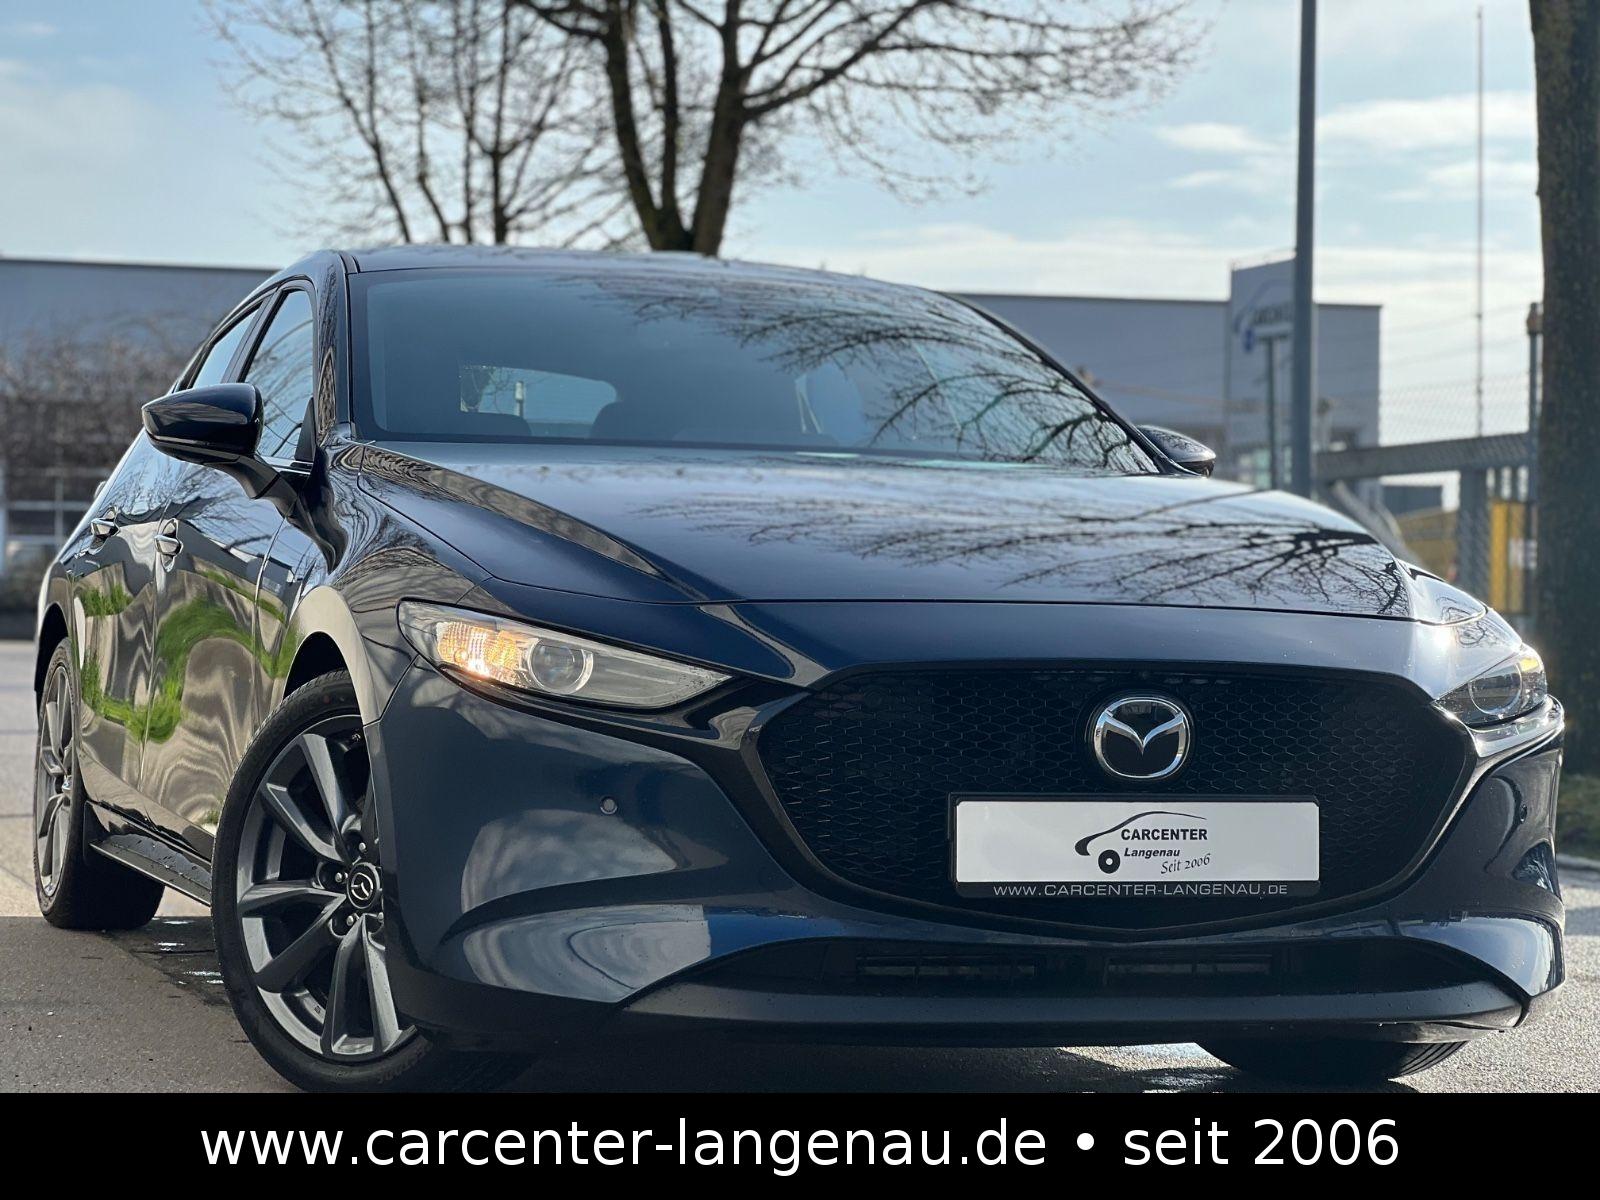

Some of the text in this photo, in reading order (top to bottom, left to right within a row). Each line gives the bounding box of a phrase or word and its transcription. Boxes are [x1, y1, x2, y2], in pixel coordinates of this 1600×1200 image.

[1120, 828, 1208, 841] CARCENTER
[1123, 847, 1181, 860] Langenau
[1160, 852, 1212, 875] Seit 2006
[993, 883, 1288, 897] WWW.CARCENTER-LANGENAU.DE
